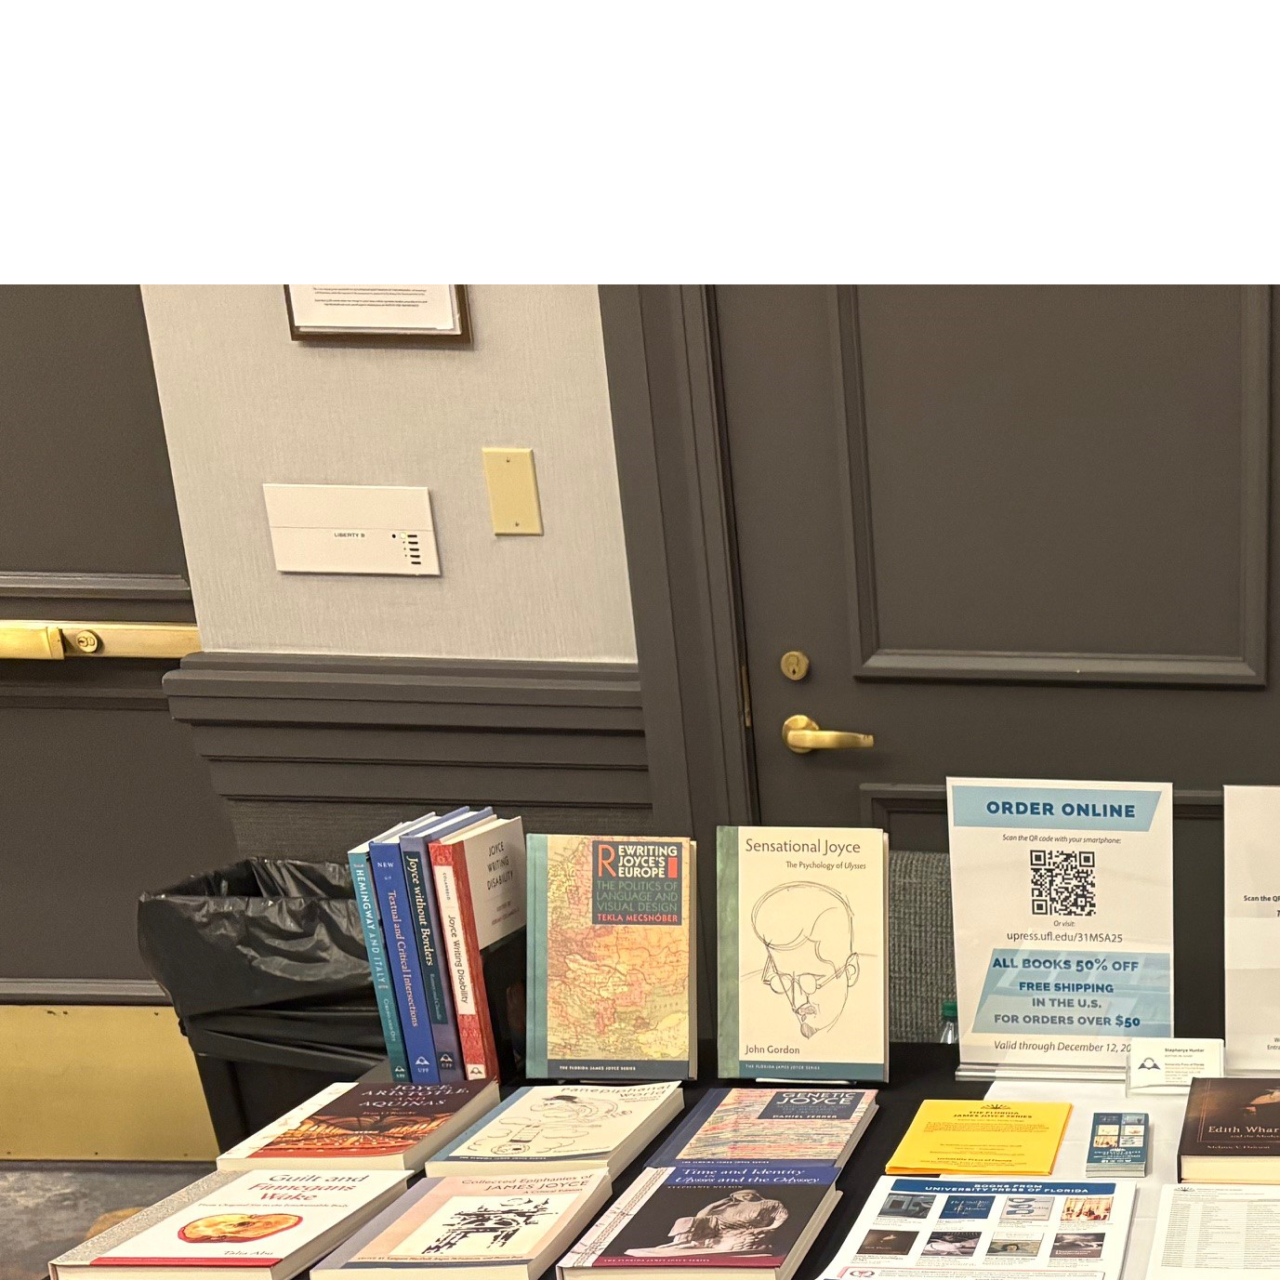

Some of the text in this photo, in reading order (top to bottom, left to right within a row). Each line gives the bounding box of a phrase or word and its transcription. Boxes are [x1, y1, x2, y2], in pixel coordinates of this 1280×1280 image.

[986, 801, 1136, 818] ORDER ONLINE
[1002, 834, 1017, 842] Scan
[1018, 834, 1028, 842] the
[488, 841, 504, 857] JOYCE
[745, 838, 861, 857] Sensational Joyce
[487, 857, 510, 873] WRITING
[618, 856, 666, 867] JOYCE'S
[786, 861, 866, 870] The Psychology of Ulysses
[618, 867, 665, 878] EUROPE
[487, 870, 514, 891] DISABILITY
[597, 880, 678, 890] THE POLITICS OF
[596, 892, 678, 901] LANGUAGE AND
[405, 855, 434, 966] Joyce without Borders
[597, 902, 677, 912] VISUAL DESIGN
[597, 913, 624, 921] TEKLA
[356, 869, 386, 983] HEMINGWAY AND ITALY
[1006, 932, 1123, 943] upress.ufl.edu/31MSA25
[448, 915, 469, 1004] Joyce Writing Disability
[992, 958, 1139, 972] ALL BOOKS 50% OFF
[1019, 981, 1114, 993] FREE SHIPPING
[1032, 998, 1102, 1009] IN THE U.S.
[994, 1014, 1140, 1028] FOR ORDERS OVER $50
[745, 1044, 800, 1055] John Gordon
[359, 1099, 446, 1108] AQUINAS
[776, 1097, 855, 1105] JOYCE
[1208, 1125, 1241, 1134] Edith
[752, 1168, 806, 1176] Identity
[269, 1173, 370, 1184] Guilt and
[520, 1175, 579, 1184] Epiphanies
[247, 1182, 358, 1194] Finnegans
[485, 1180, 590, 1191] JAMES JOYCE
[259, 1192, 318, 1201] Wake
